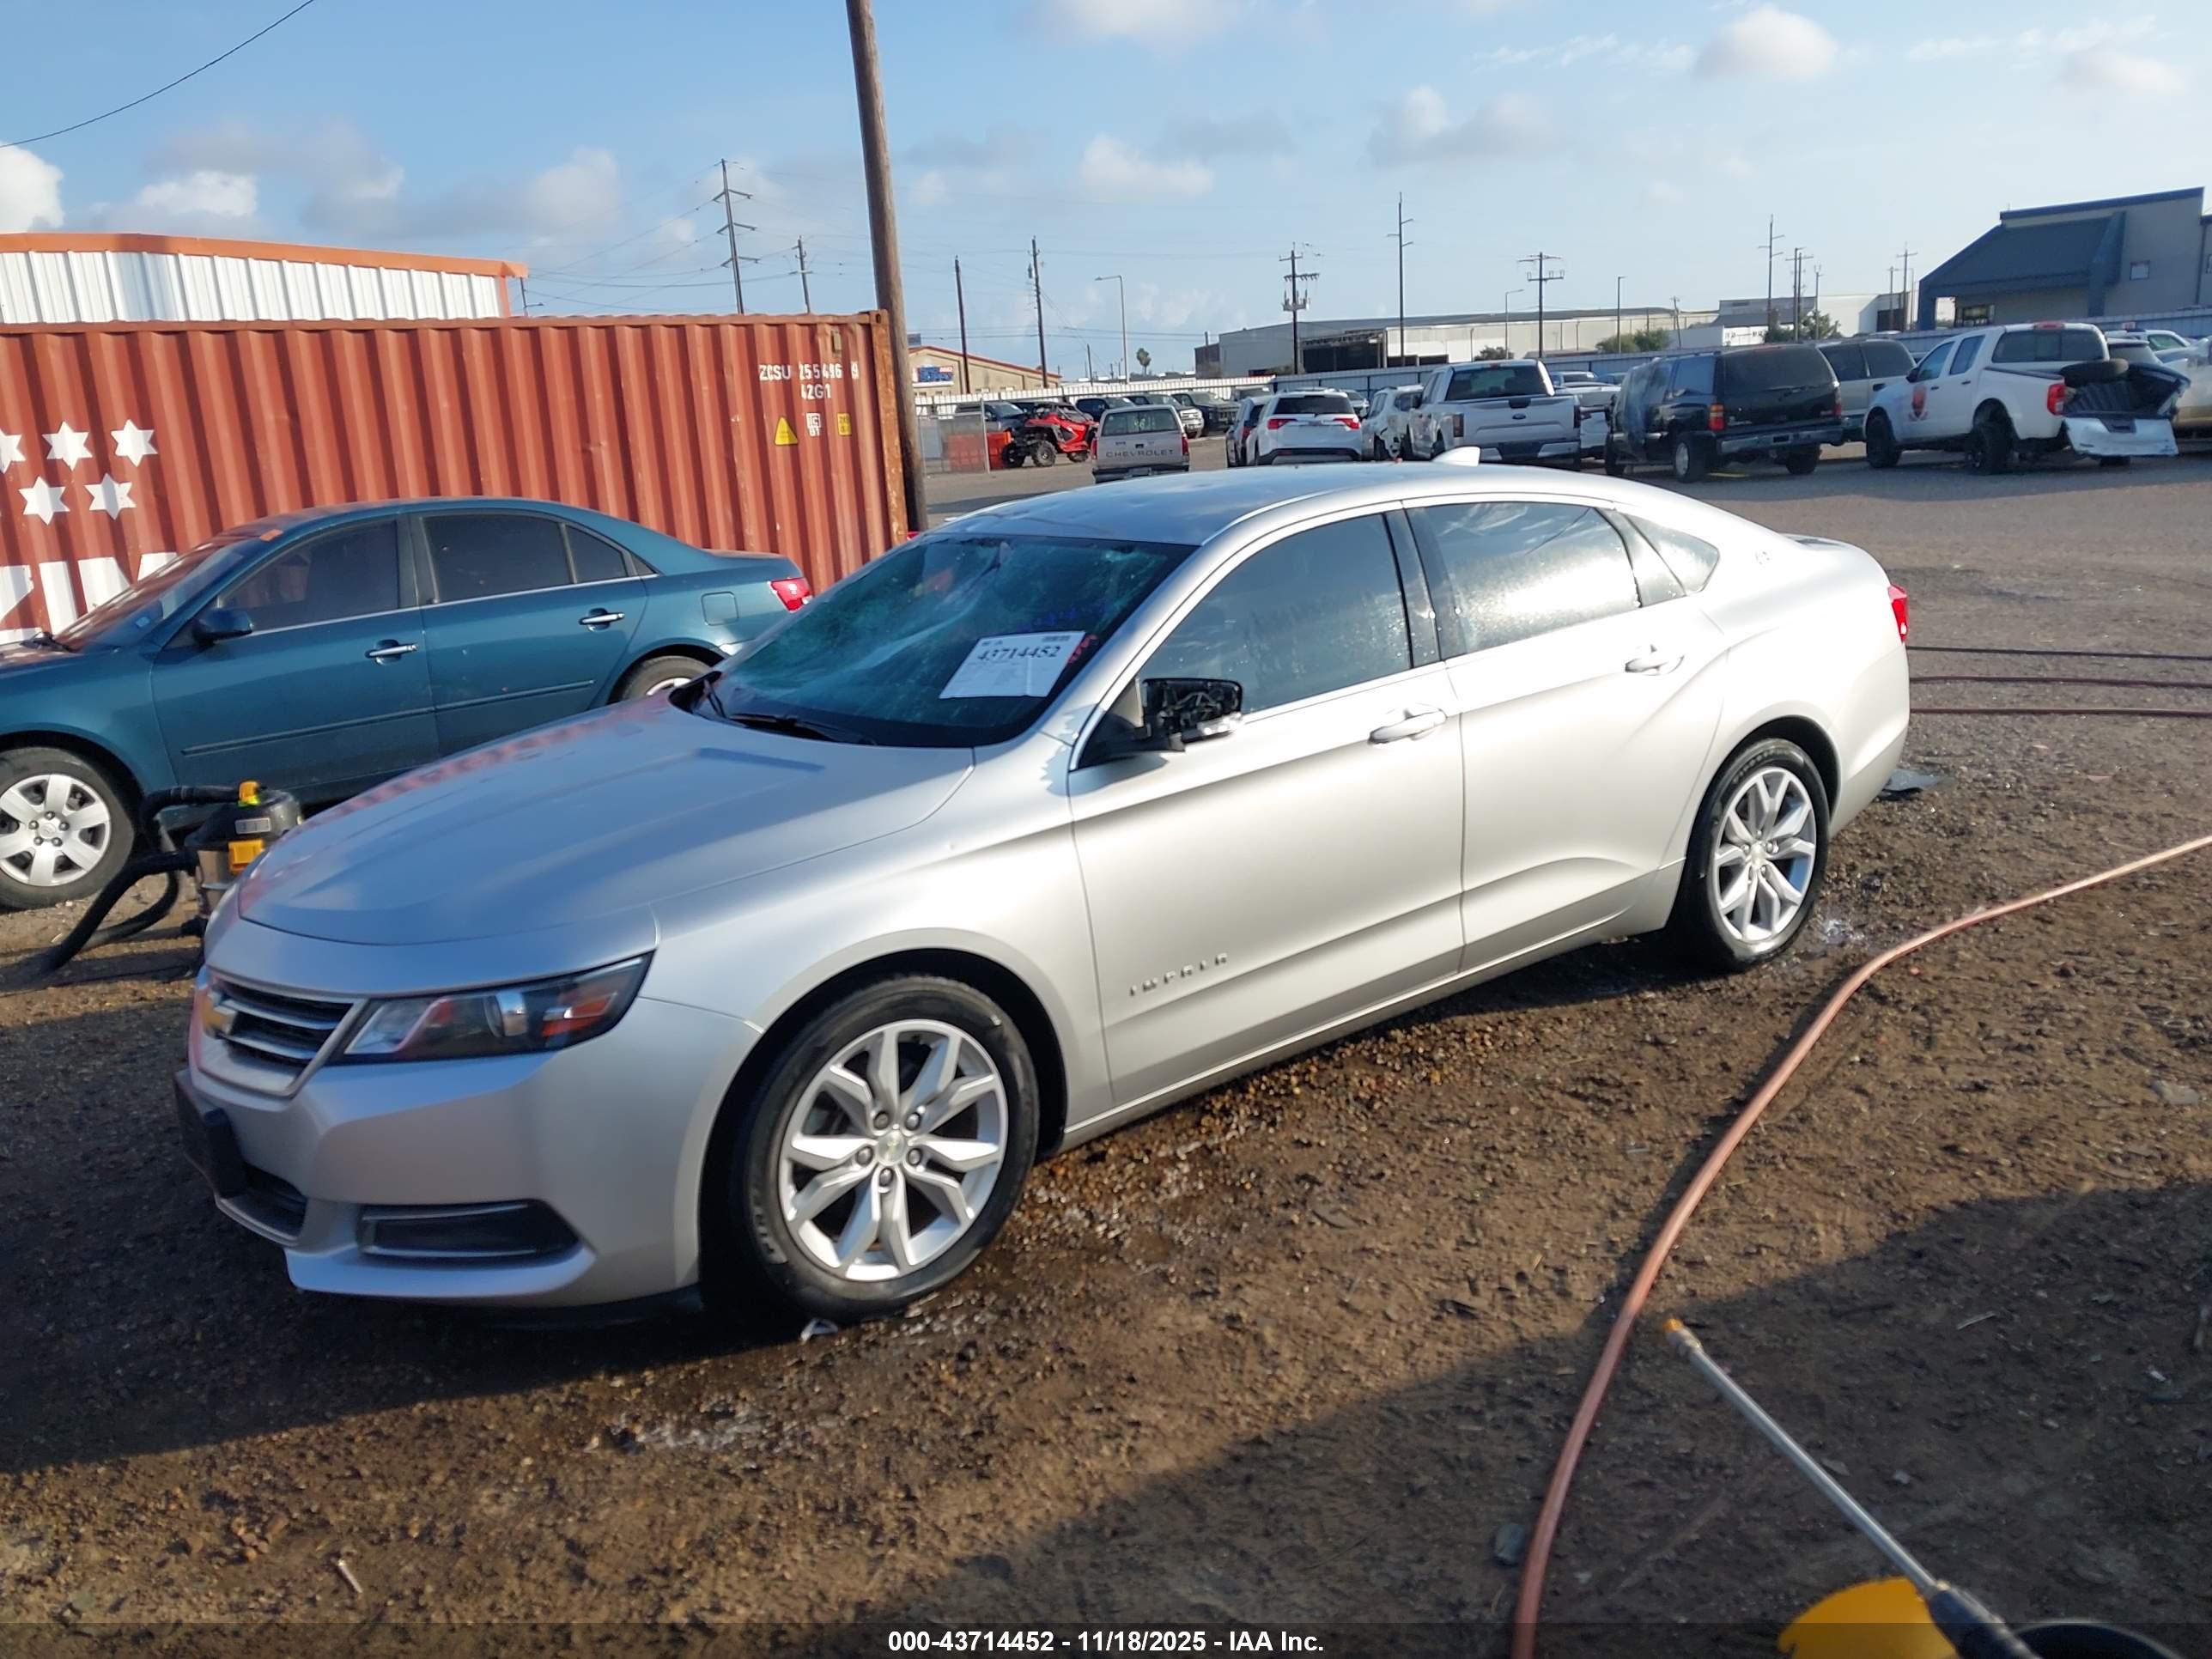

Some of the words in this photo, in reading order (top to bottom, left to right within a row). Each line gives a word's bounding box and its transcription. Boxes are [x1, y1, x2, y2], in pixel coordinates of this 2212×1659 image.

[759, 364, 792, 381] ZCSU
[801, 384, 831, 399] 42G1
[1105, 448, 1176, 458] CHEVROLET
[977, 646, 1061, 661] 43714452
[1129, 953, 1228, 996] IMPALA
